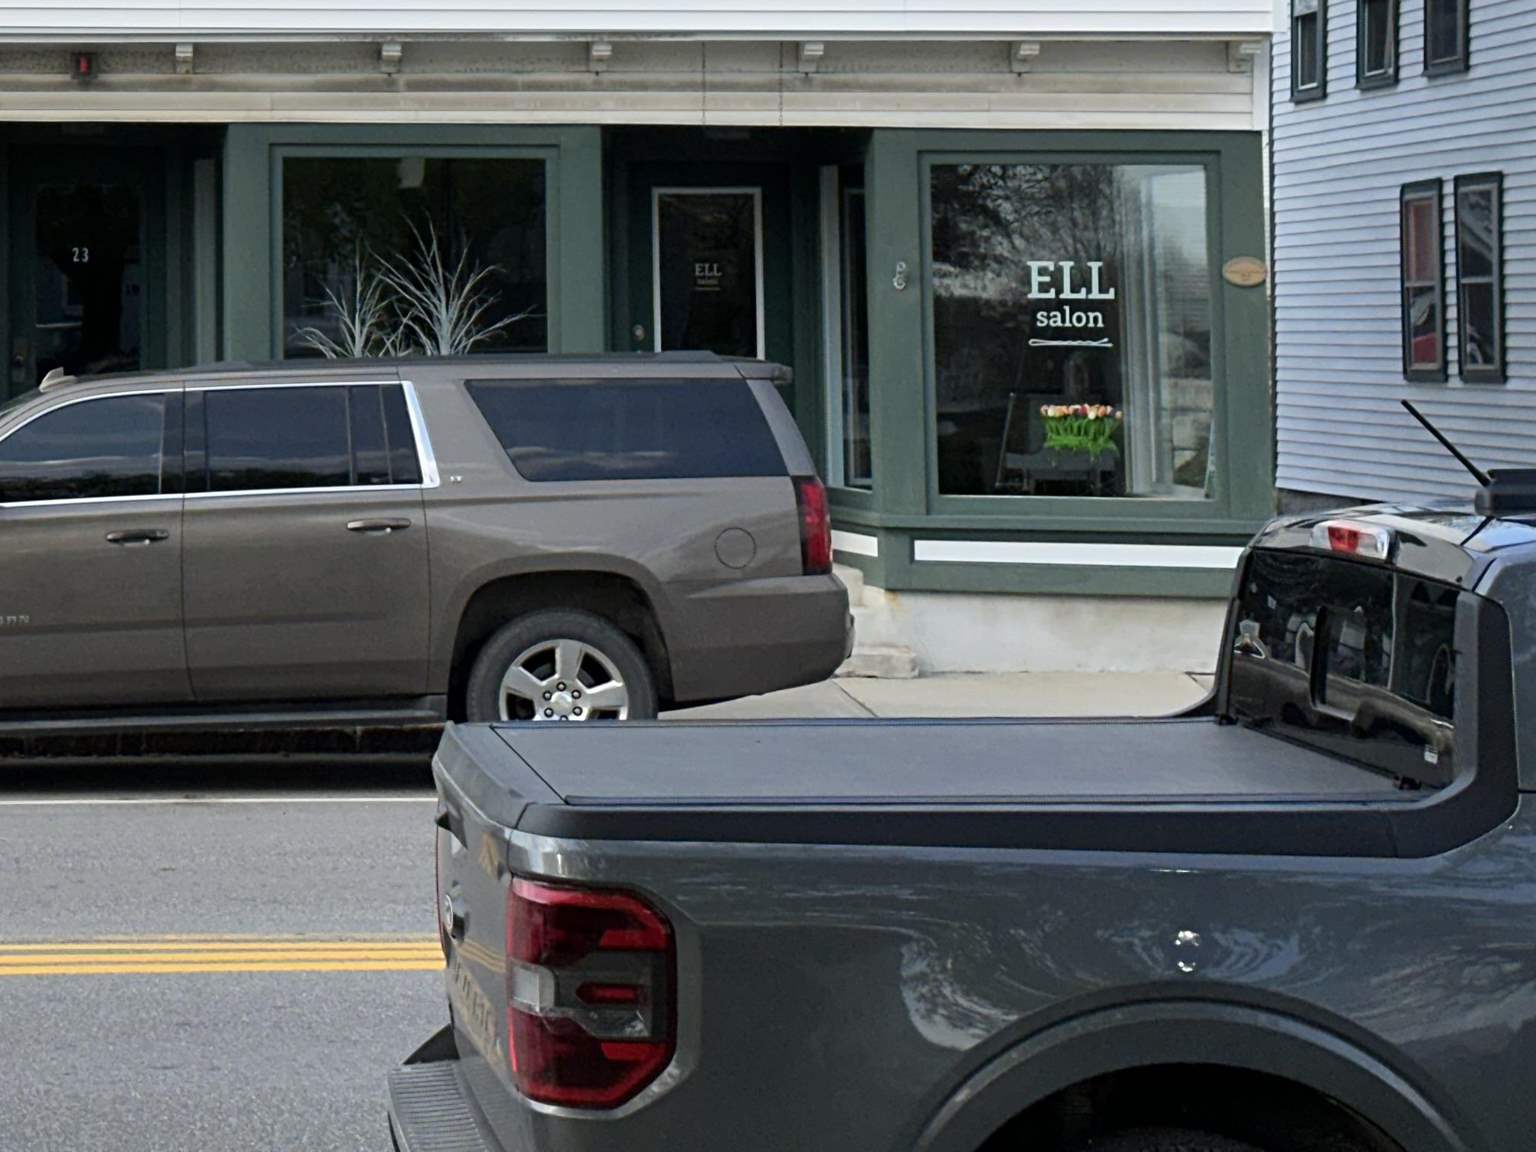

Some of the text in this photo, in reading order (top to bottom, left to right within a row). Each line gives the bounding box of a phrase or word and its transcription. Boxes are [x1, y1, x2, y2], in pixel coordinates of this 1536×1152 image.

[72, 247, 89, 262] 23
[695, 263, 722, 277] ELL
[1026, 261, 1115, 300] ELL
[1035, 305, 1105, 328] salon
